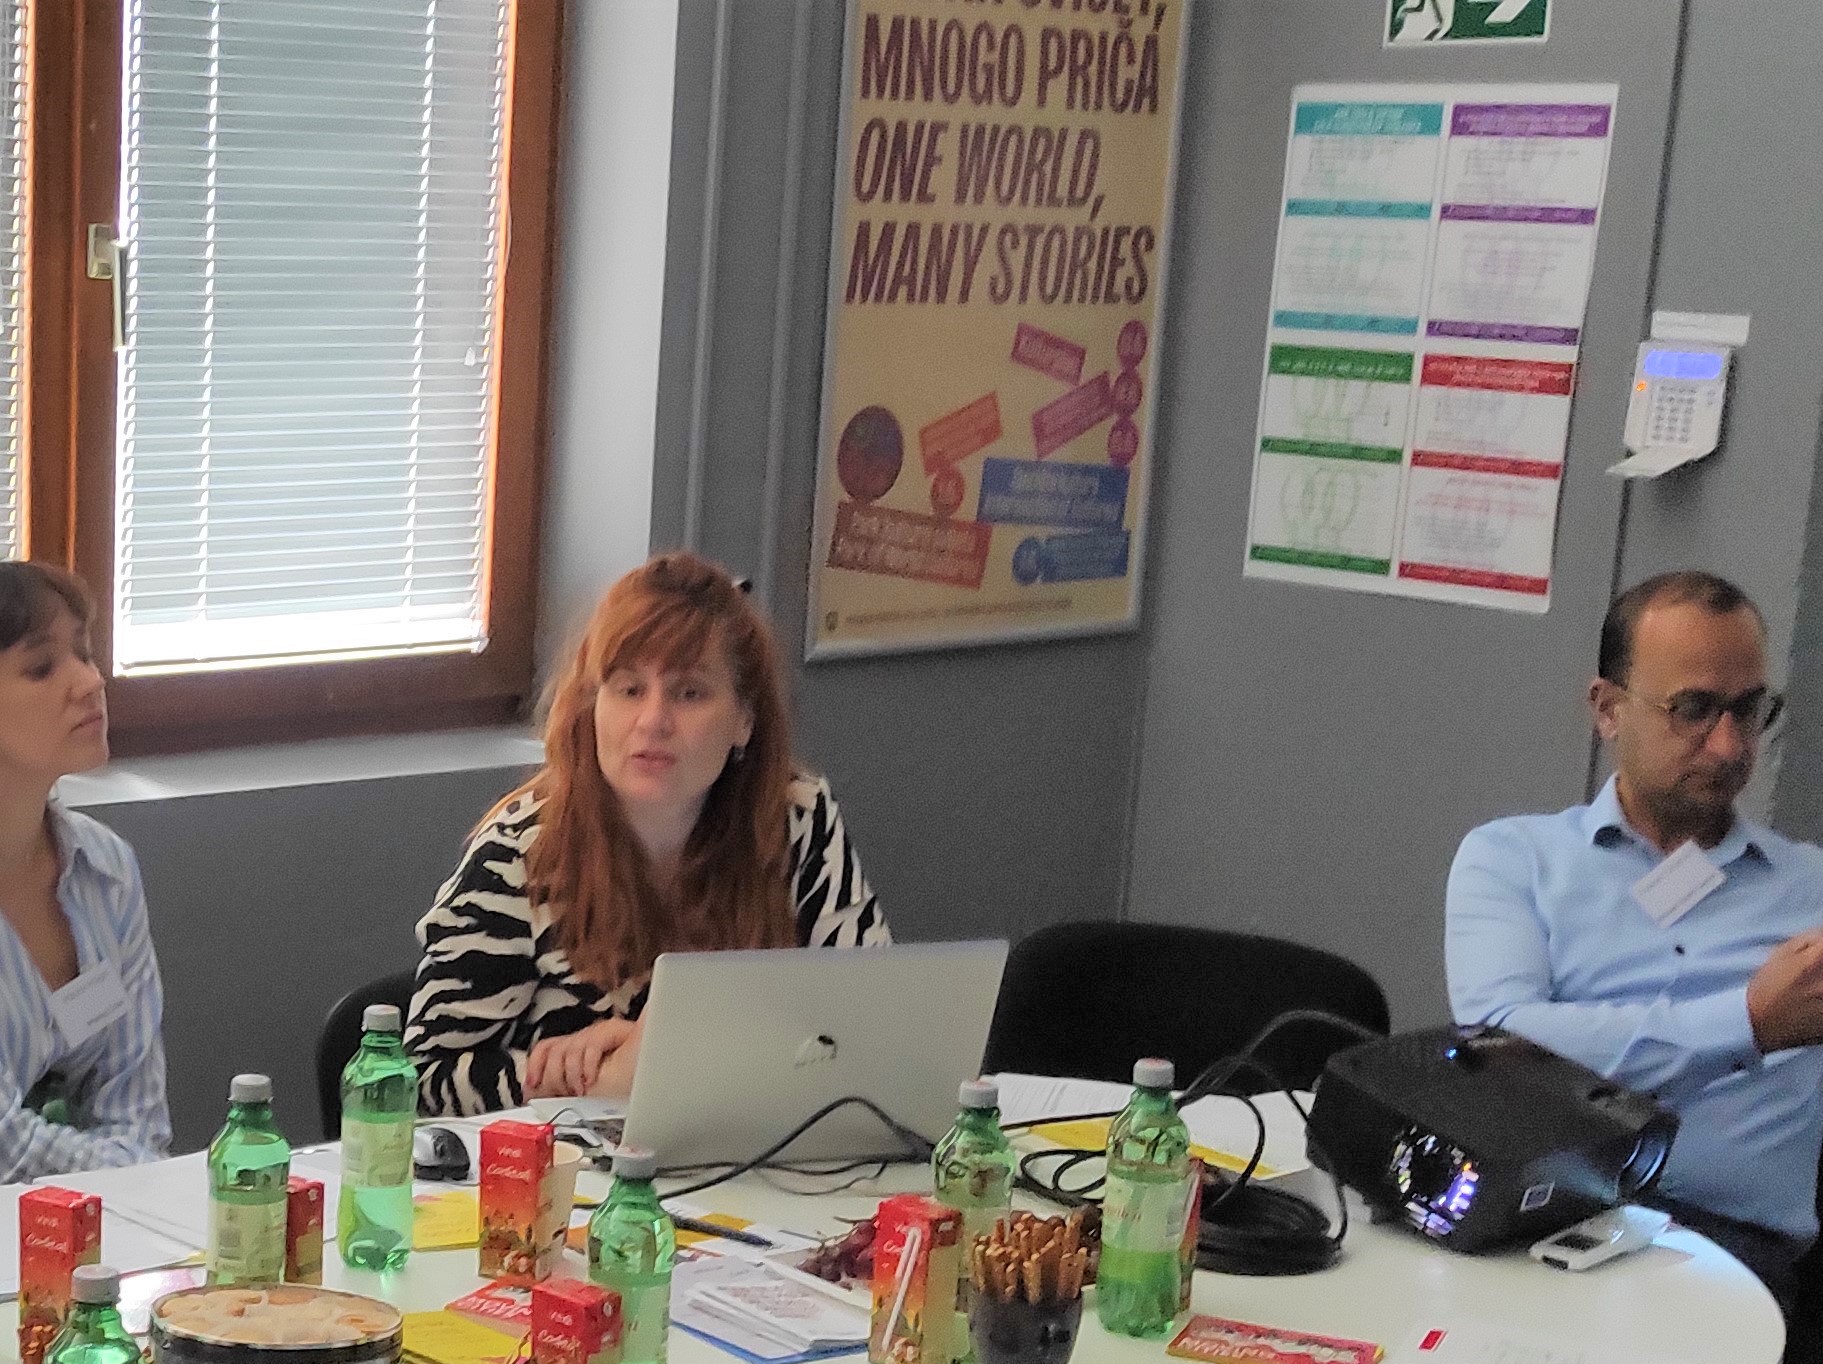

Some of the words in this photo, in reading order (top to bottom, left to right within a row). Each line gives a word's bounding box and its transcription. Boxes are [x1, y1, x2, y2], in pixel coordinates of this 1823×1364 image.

[861, 13, 1025, 107] MNOGO
[1036, 17, 1160, 114] PRIČA
[853, 117, 950, 203] ONE
[953, 123, 1106, 222] WORLD,
[845, 220, 990, 305] MANY
[989, 222, 1156, 305] STORIES
